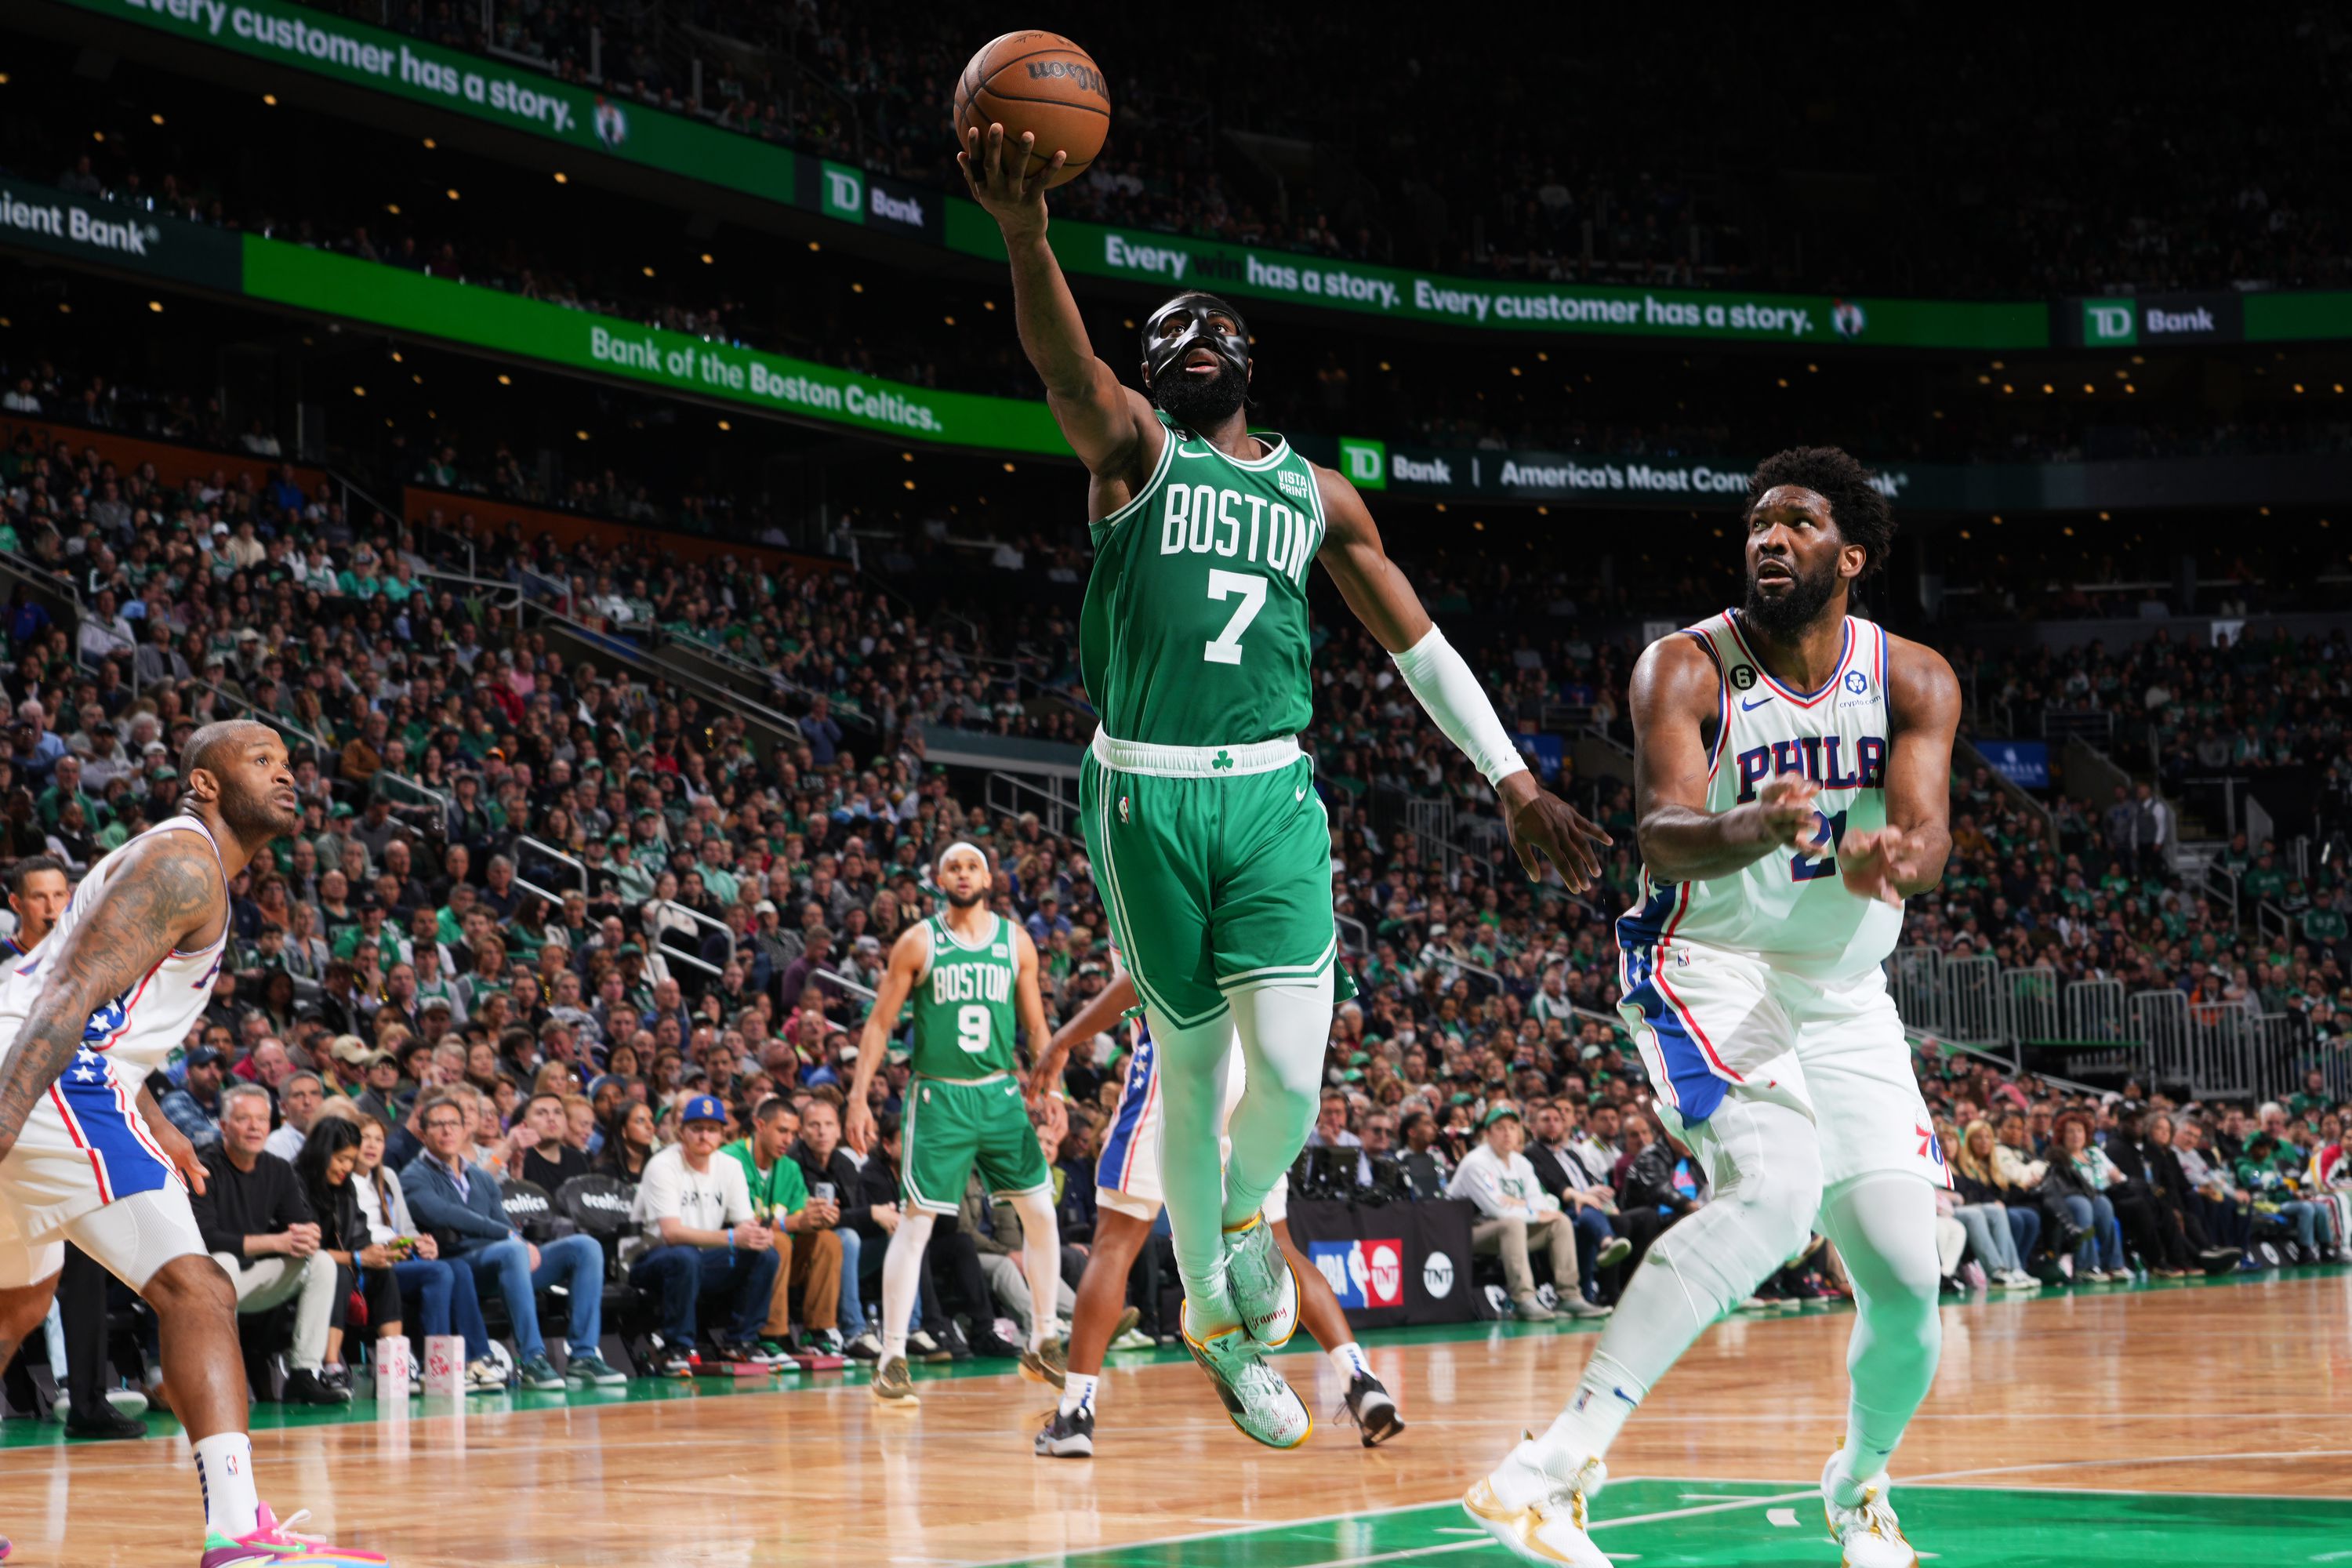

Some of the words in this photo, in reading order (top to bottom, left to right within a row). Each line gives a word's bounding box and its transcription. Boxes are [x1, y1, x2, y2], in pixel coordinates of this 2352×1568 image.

[232, 6, 394, 76] customer
[400, 45, 458, 95] has
[464, 73, 484, 103] a
[489, 80, 575, 132] story.
[826, 170, 861, 212] TD
[871, 187, 924, 227] Bank
[1105, 235, 1187, 281] Every
[1193, 251, 1242, 281] win
[1247, 256, 1298, 292] has
[1302, 271, 1320, 294] a
[1324, 272, 1400, 308] story.
[1414, 279, 1490, 322] Every
[1495, 295, 1640, 325] customer
[1646, 295, 1700, 327] has
[1705, 304, 1726, 328] a
[1730, 303, 1813, 336] story.
[2089, 306, 2132, 338] TD
[2147, 306, 2214, 332] Bank
[591, 326, 660, 372] Bank
[666, 347, 696, 379] of
[700, 353, 745, 390] the
[750, 363, 841, 410] Boston
[845, 383, 943, 432] Celtics.
[1277, 470, 1308, 489] VISTA
[1344, 446, 1382, 481] TD
[1392, 454, 1452, 484] Bank
[1501, 459, 1624, 489] America's
[1626, 464, 1690, 492] Most
[1279, 481, 1308, 499] PRINT
[1160, 484, 1316, 588] BOSTON
[1203, 568, 1268, 665] 7
[1736, 668, 1751, 688] 6
[1839, 695, 1882, 709] crypto.com
[933, 963, 1011, 1005] BOSTON
[957, 1005, 991, 1053] 9
[1372, 1266, 1399, 1285] TNT
[1423, 1268, 1454, 1285] TNT
